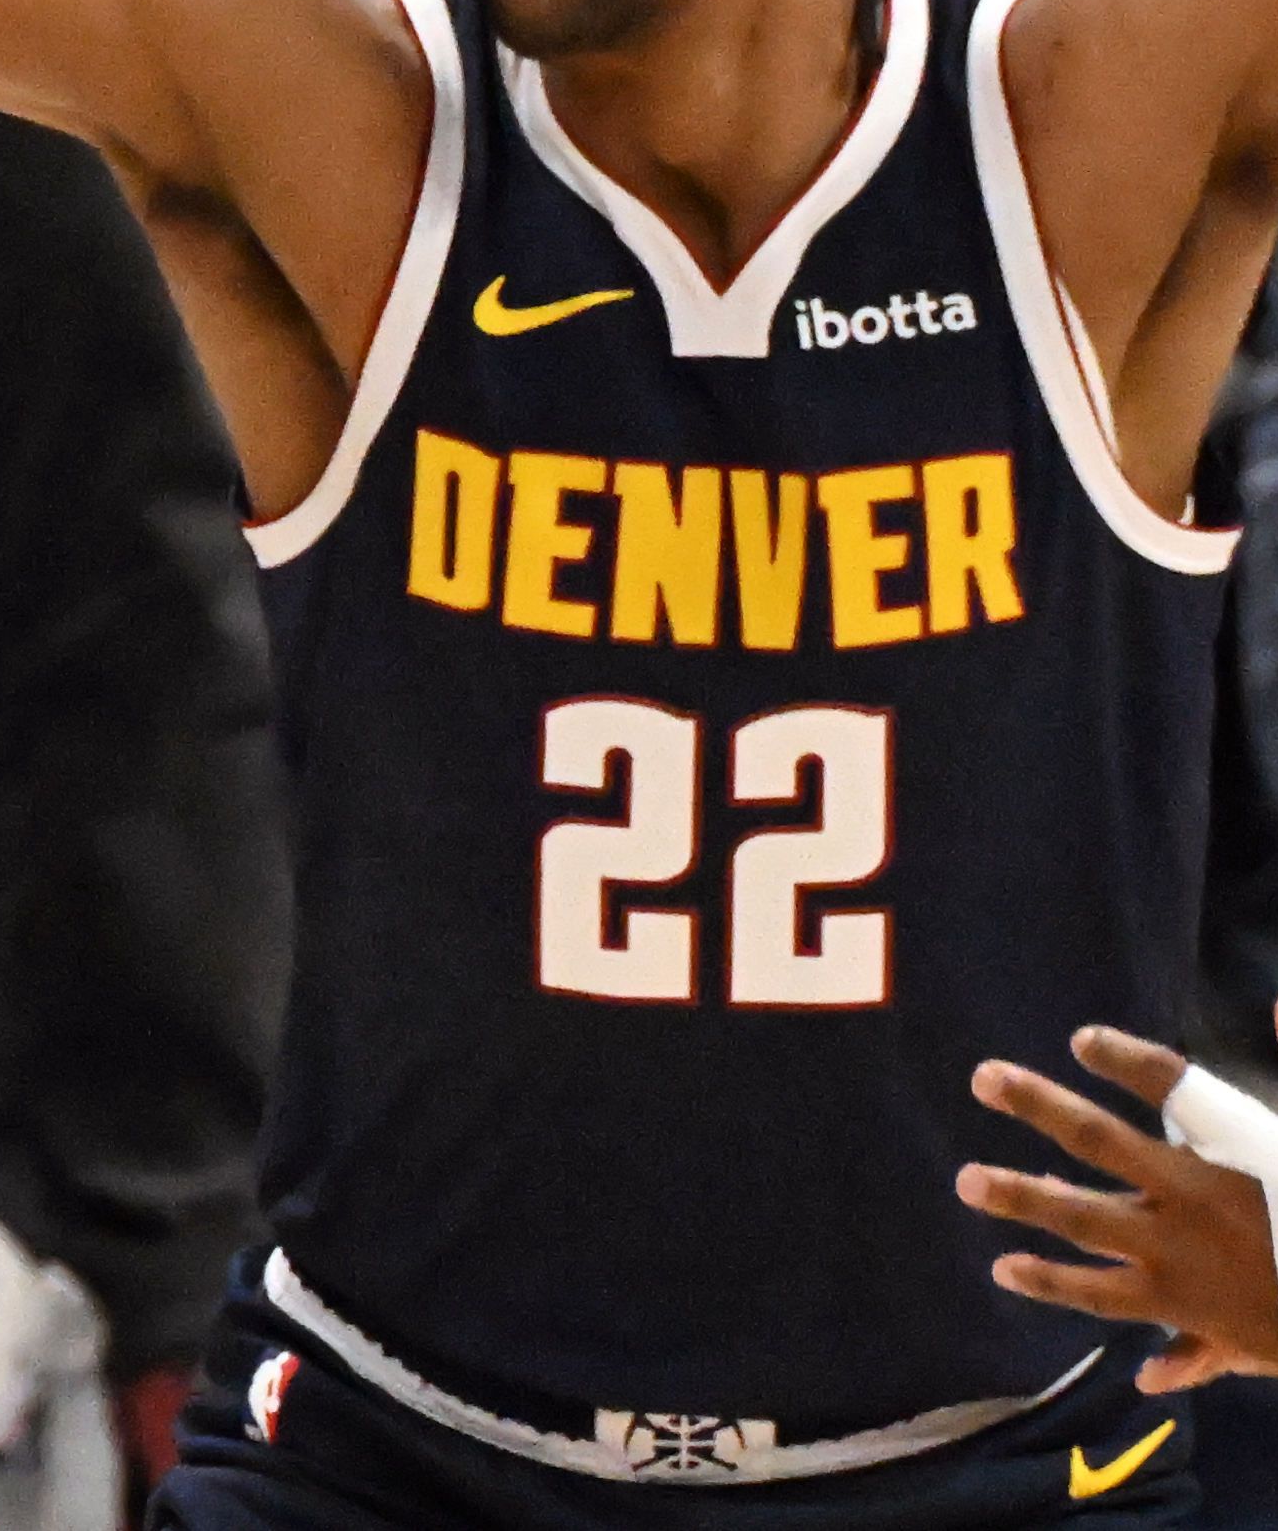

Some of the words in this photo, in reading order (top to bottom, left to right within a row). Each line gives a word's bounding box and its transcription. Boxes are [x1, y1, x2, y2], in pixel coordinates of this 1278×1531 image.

[793, 289, 978, 352] ibotta
[406, 425, 1026, 653] DENVER
[535, 693, 894, 1008] 22
